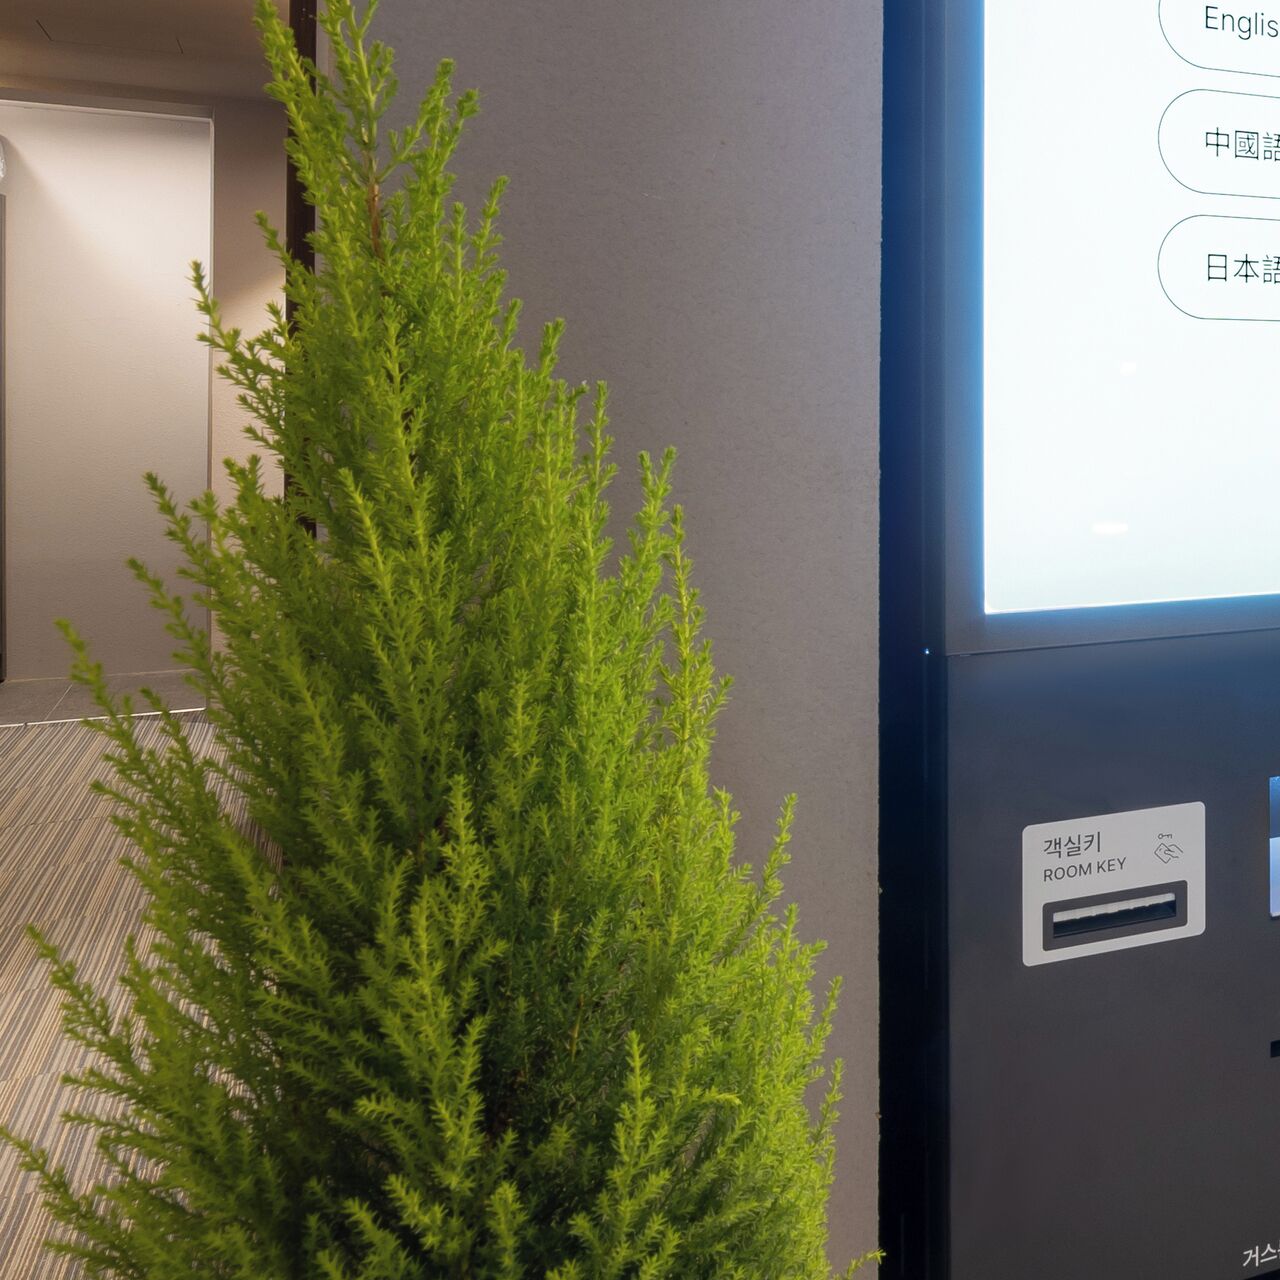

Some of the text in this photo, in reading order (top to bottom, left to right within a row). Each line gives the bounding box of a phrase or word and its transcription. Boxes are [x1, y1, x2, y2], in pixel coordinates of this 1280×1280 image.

[1043, 831, 1100, 859] 객실키
[1044, 857, 1126, 882] ROOM KEY
